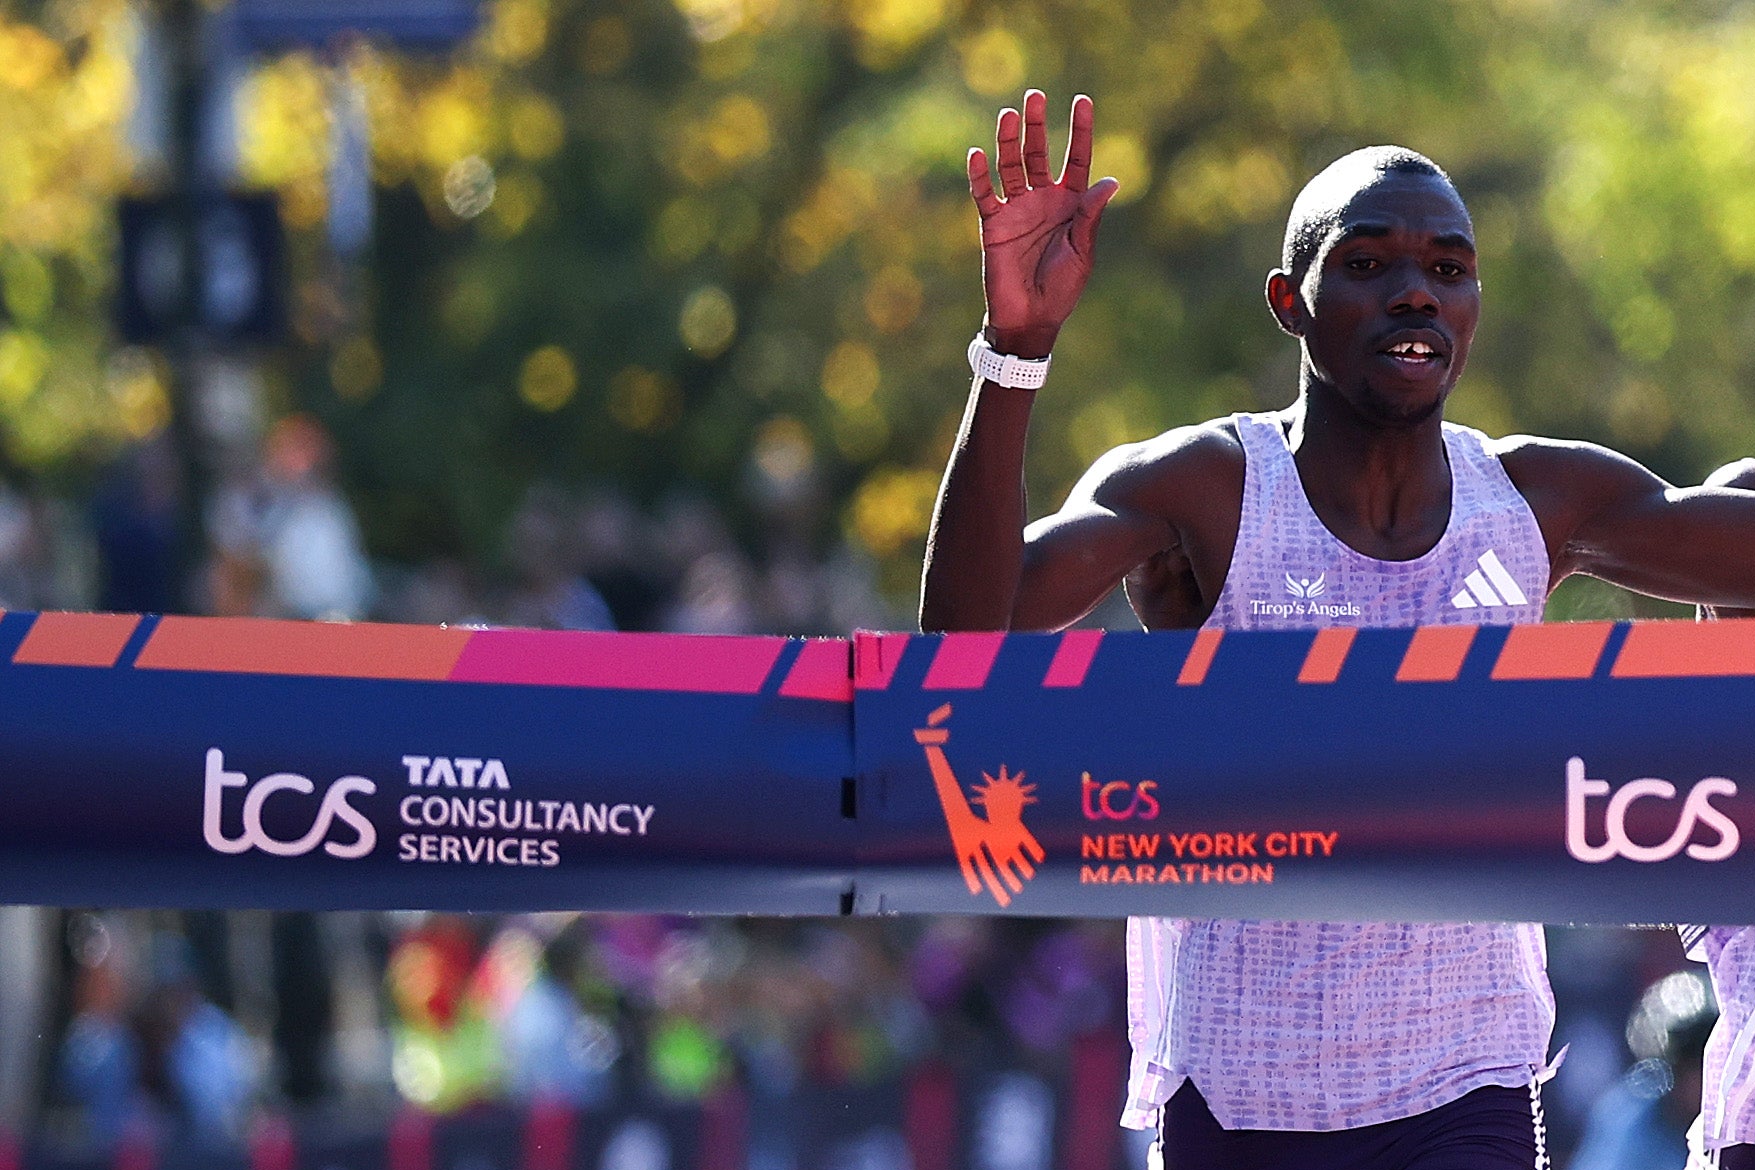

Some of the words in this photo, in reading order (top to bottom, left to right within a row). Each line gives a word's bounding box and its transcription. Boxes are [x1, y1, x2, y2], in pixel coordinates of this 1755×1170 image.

[1250, 600, 1305, 618] Tirop's
[1307, 602, 1361, 619] Angels
[402, 755, 511, 790] TATA
[204, 747, 377, 859] tcs
[1081, 771, 1161, 821] tcs
[1566, 756, 1740, 863] tcs
[399, 795, 655, 836] CONSULTANCY
[399, 833, 561, 866] SERVICES
[1081, 833, 1161, 860] NEW
[1168, 832, 1258, 858] YORK
[1264, 830, 1340, 857] CITY
[1079, 863, 1275, 885] MARATHON
